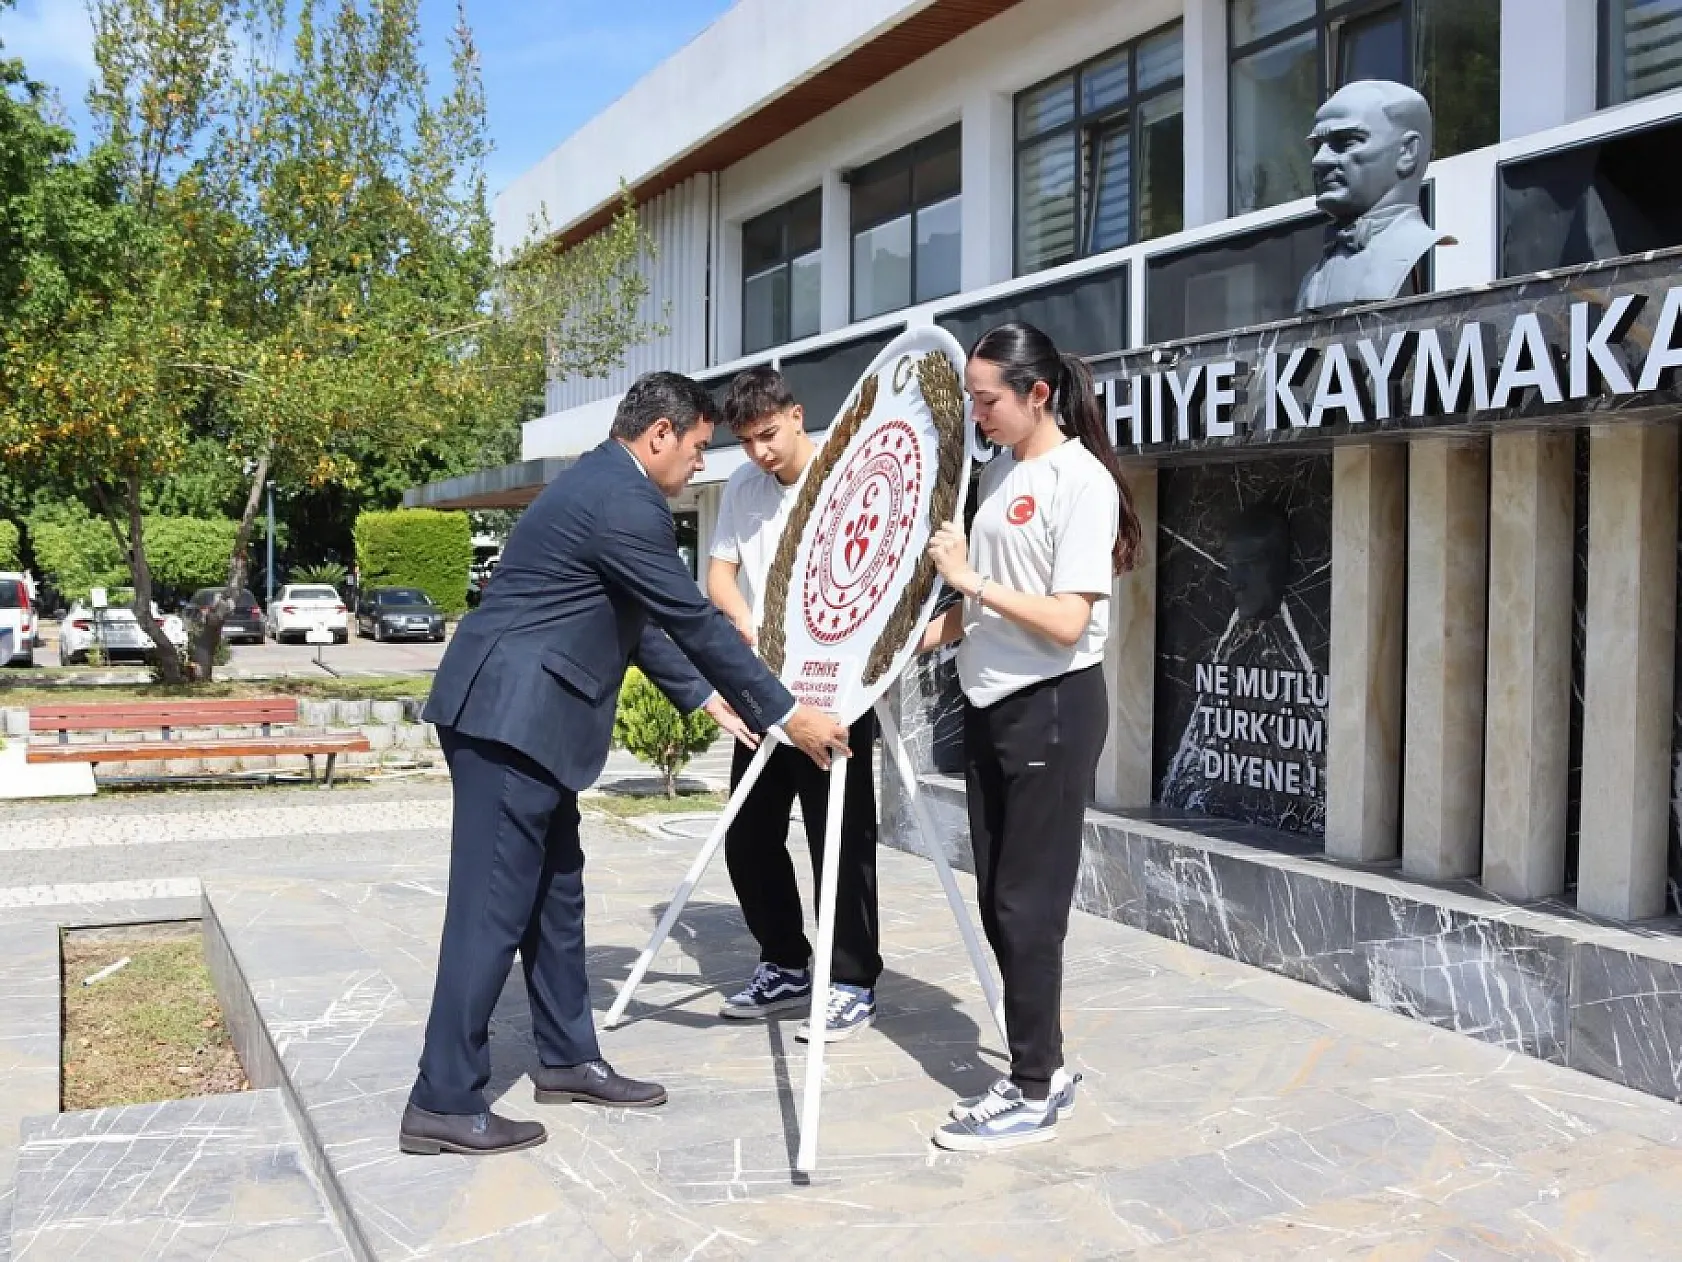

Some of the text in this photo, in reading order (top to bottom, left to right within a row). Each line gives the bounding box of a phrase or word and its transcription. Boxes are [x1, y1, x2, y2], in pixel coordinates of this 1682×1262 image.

[1095, 349, 1236, 447] HİYE
[1195, 663, 1329, 707] NE MUTLU
